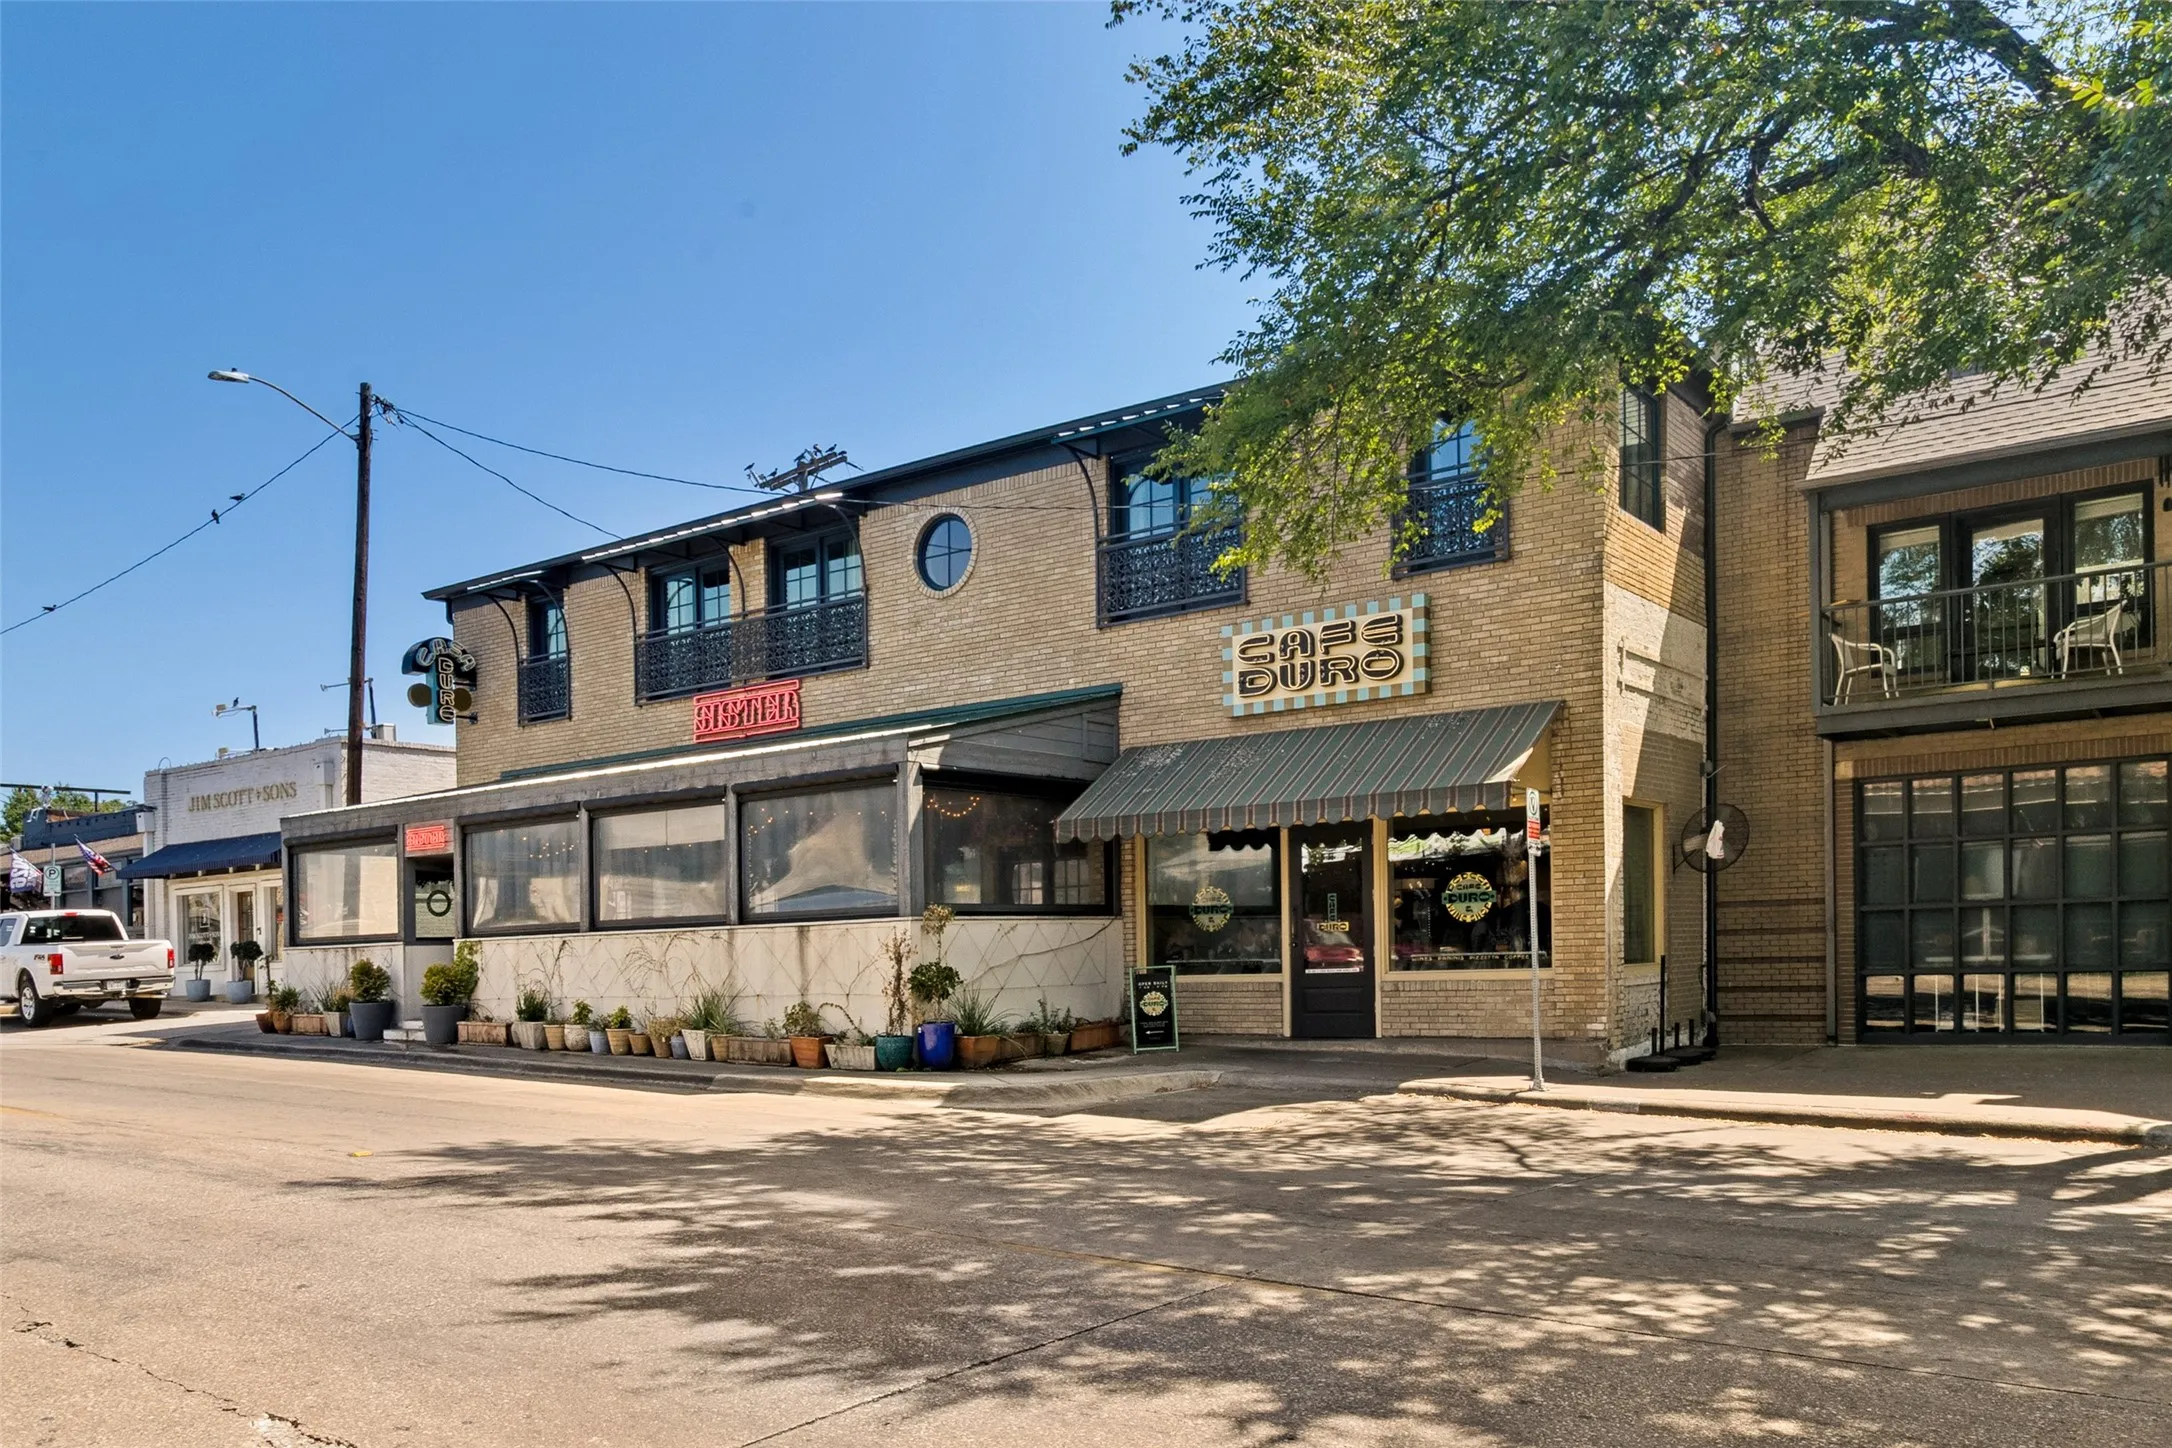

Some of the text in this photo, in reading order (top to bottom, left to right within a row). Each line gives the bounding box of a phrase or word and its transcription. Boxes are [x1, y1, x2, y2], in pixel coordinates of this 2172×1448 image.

[415, 638, 477, 672] CASA
[1237, 613, 1403, 665] CAFE
[1238, 647, 1404, 698] DURO
[438, 657, 456, 721] DURO
[694, 690, 799, 733] SISTER
[188, 794, 211, 812] JIM
[212, 788, 254, 809] SCOTT
[262, 782, 297, 802] SONS
[1448, 892, 1490, 903] DURO
[1456, 883, 1482, 891] CAFE
[1193, 905, 1229, 914] DURO
[1318, 922, 1348, 931] DURO
